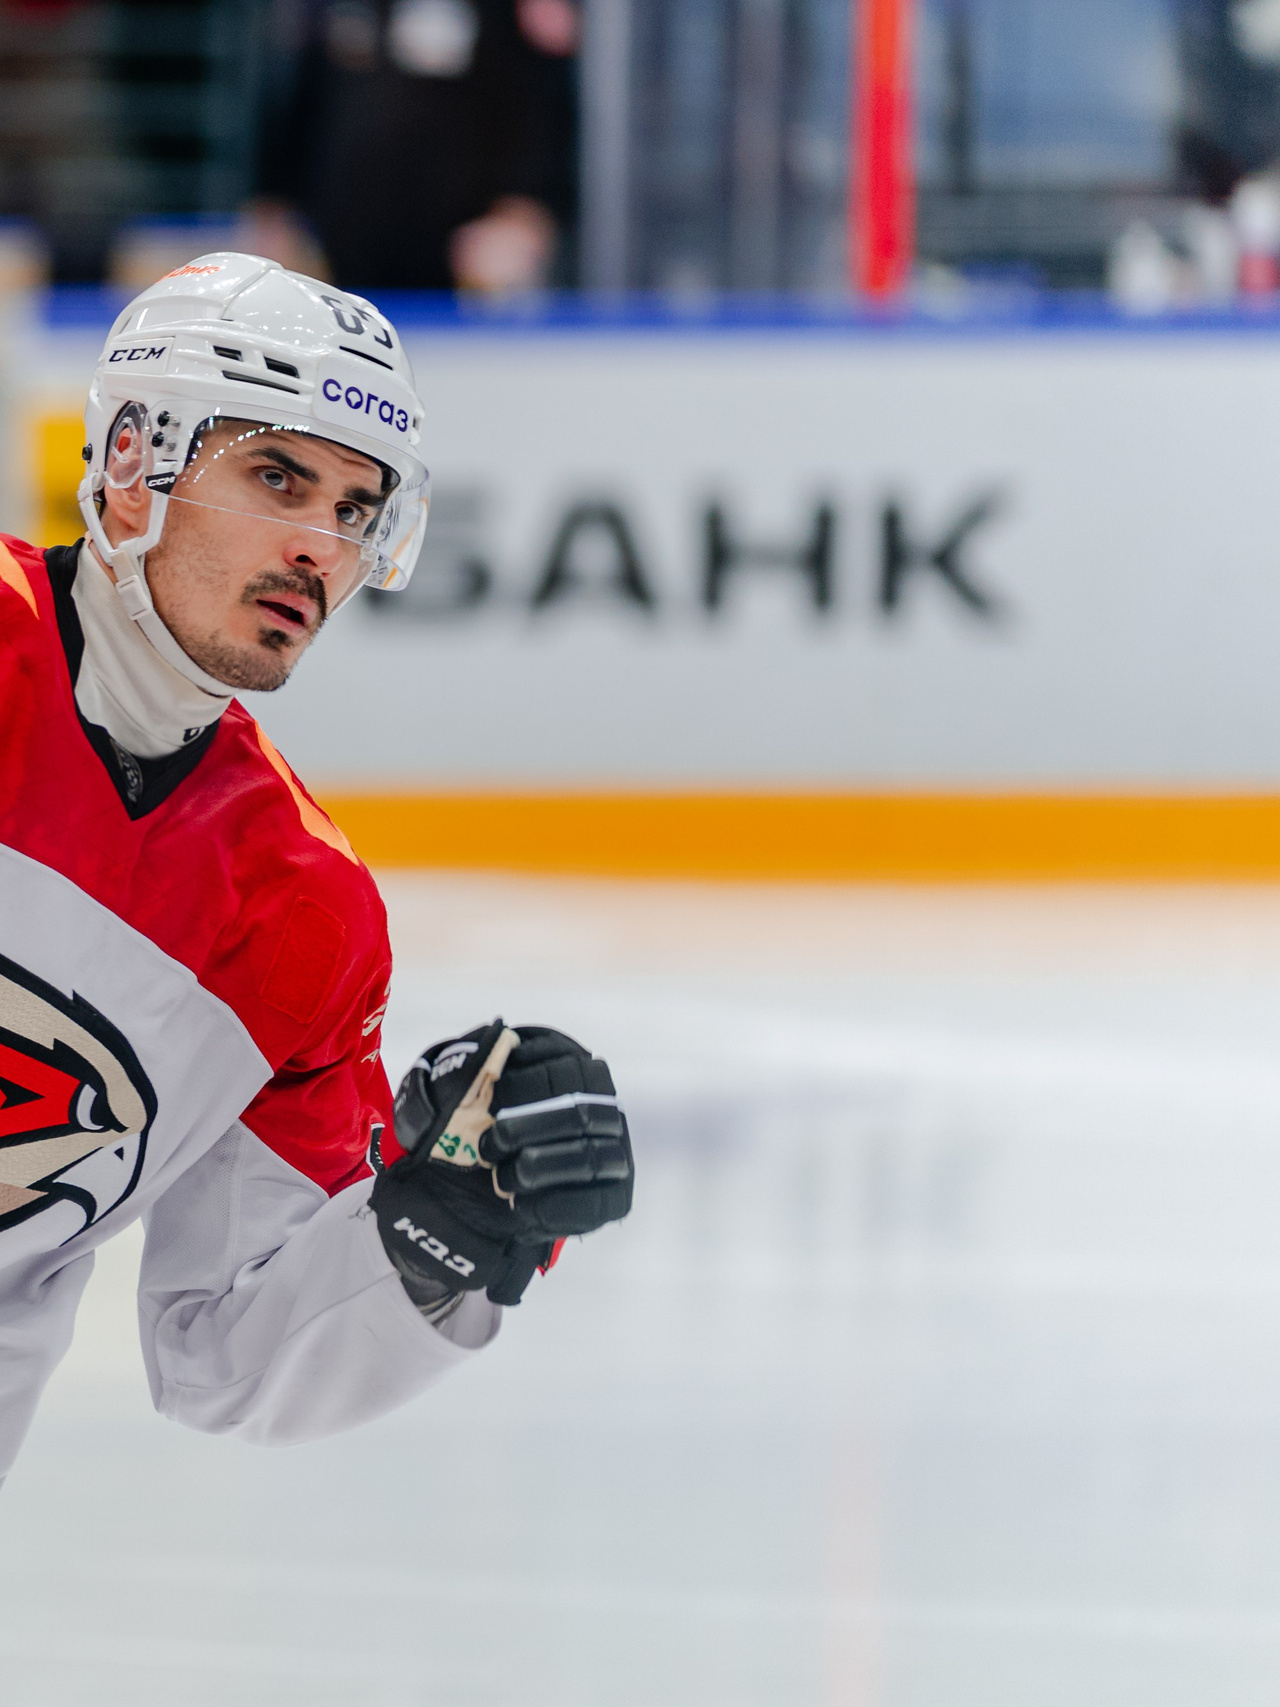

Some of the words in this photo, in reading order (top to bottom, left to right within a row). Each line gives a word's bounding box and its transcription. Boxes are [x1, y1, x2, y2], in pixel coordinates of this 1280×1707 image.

[108, 346, 167, 362] CCM
[147, 475, 176, 487] CCM
[393, 1216, 476, 1278] CCM
